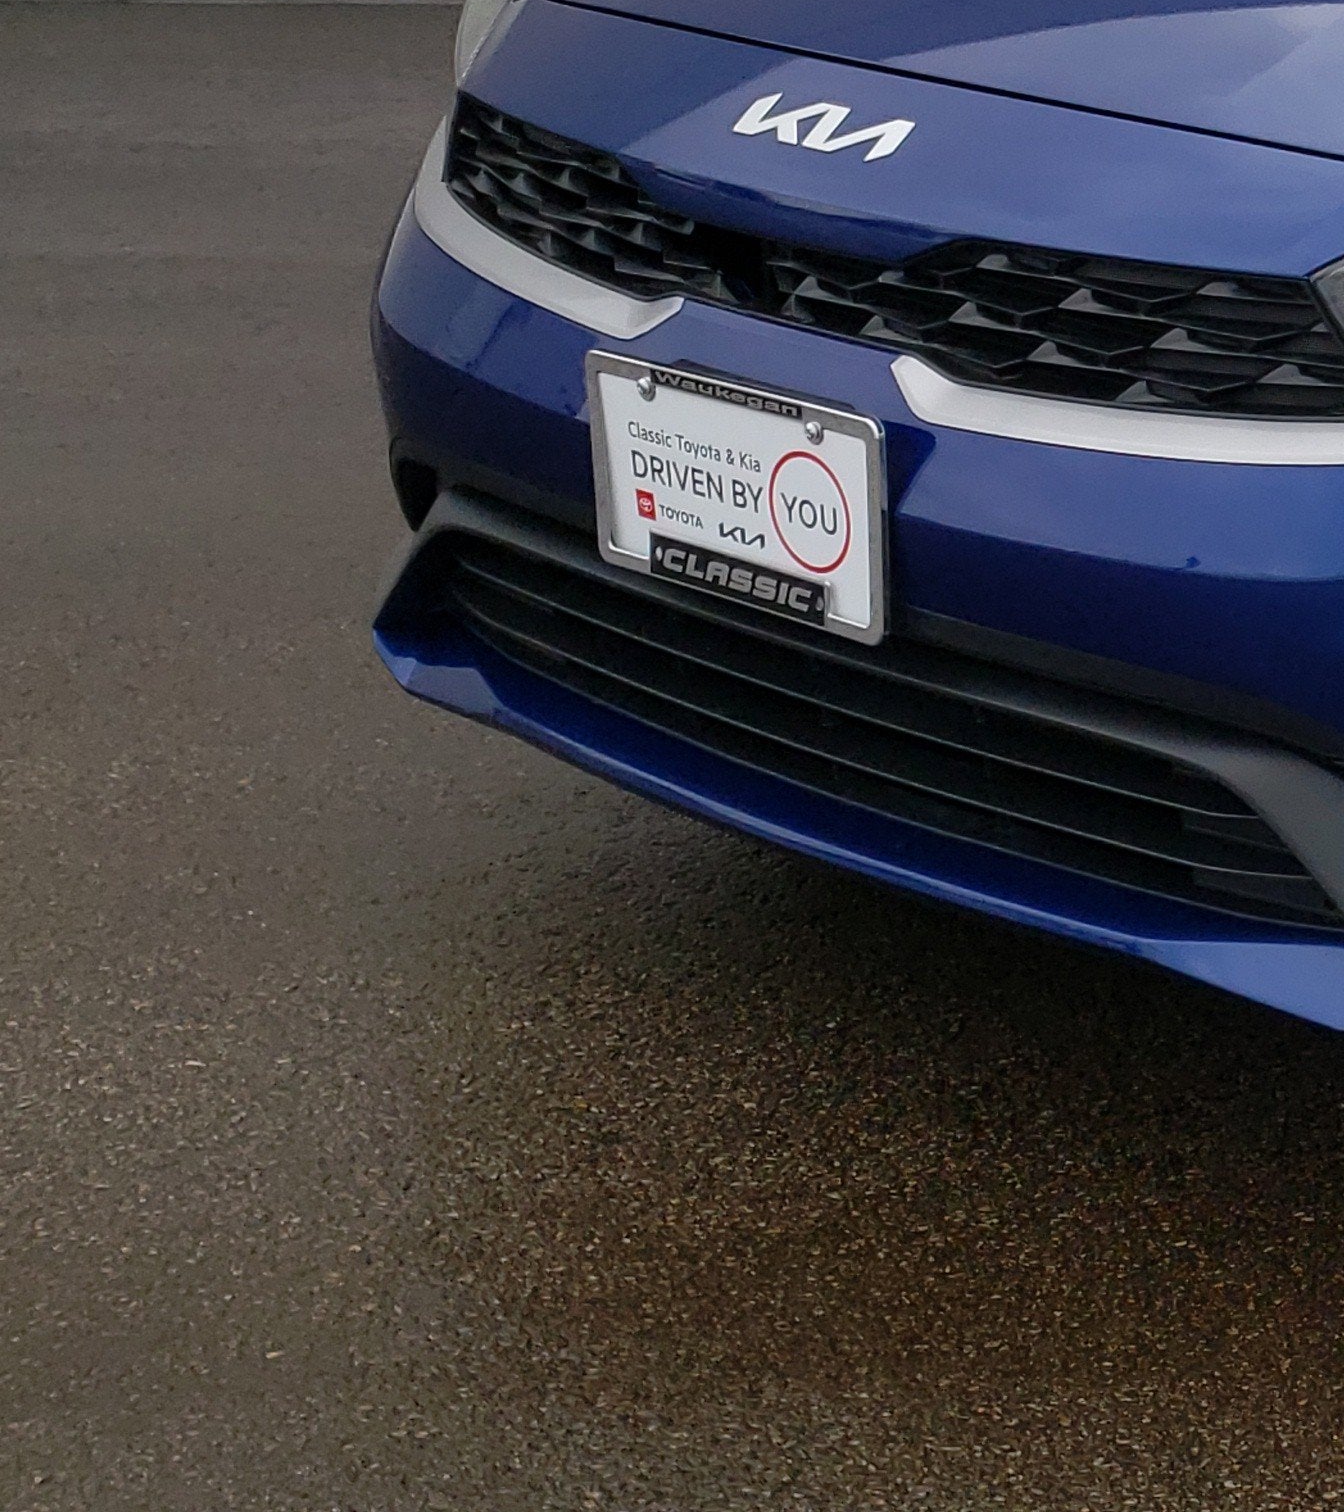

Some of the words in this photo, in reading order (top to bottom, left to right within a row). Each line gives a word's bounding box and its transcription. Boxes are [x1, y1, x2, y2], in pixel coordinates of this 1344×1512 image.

[733, 91, 916, 162] KIA
[653, 369, 800, 418] Waukegan
[628, 420, 672, 448] Classic
[675, 433, 721, 463] Toyota
[725, 448, 735, 465] &
[739, 450, 762, 474] Kia
[631, 449, 725, 504] DRIVEN
[731, 478, 764, 514] BY
[780, 492, 838, 536] YOU
[658, 503, 704, 529] TOYOTA
[661, 548, 812, 612] CLASSIC
